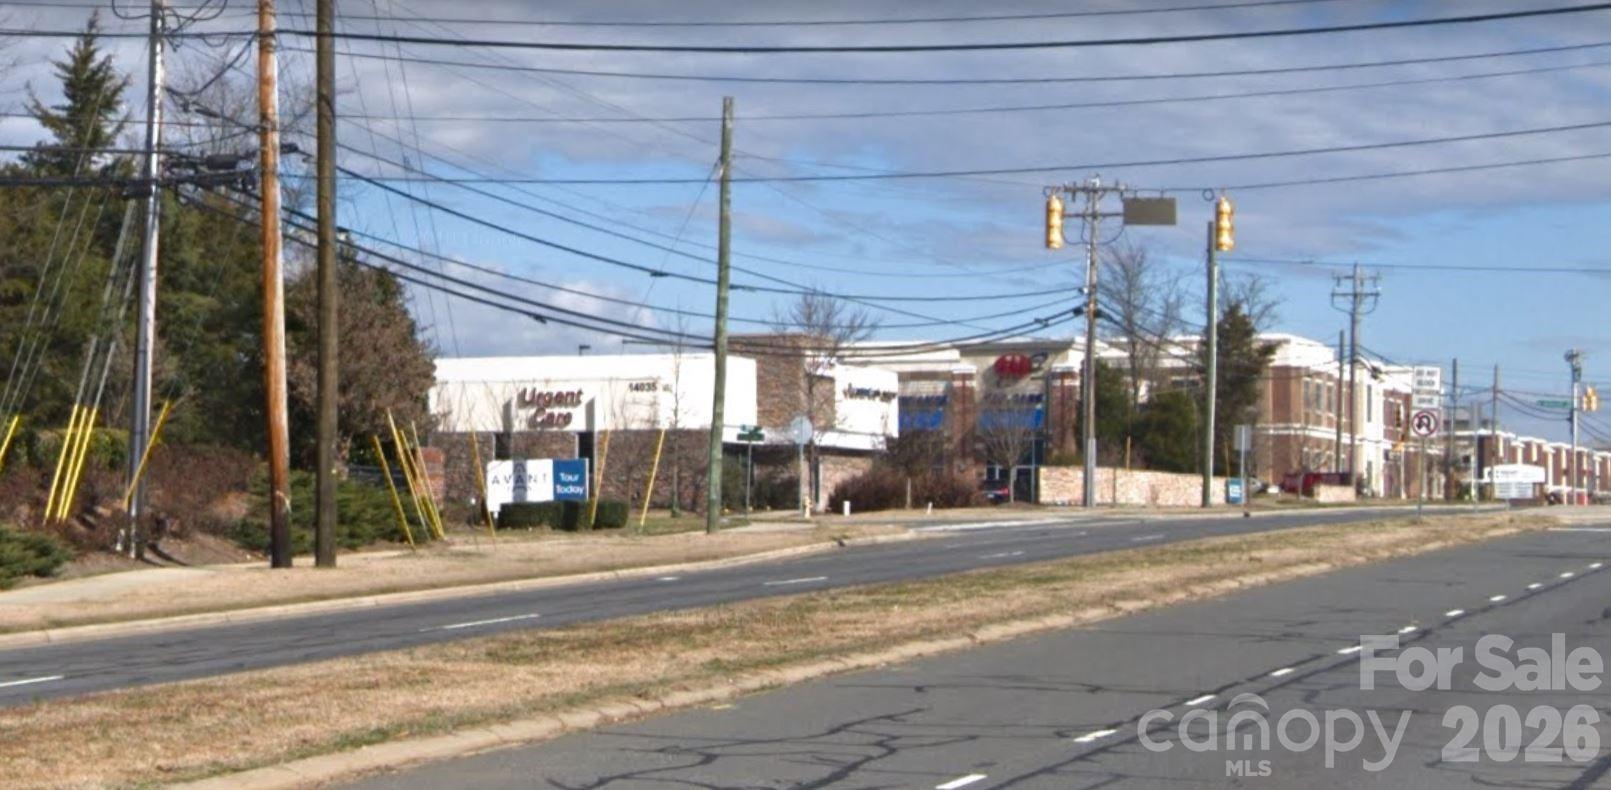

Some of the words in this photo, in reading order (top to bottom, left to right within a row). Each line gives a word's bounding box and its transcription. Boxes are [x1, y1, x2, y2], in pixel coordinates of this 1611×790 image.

[629, 382, 658, 392] 14035
[519, 387, 584, 411] Urgent
[531, 407, 574, 427] Care
[491, 472, 548, 484] AVANT
[559, 472, 580, 482] Tour
[555, 484, 585, 495] Today
